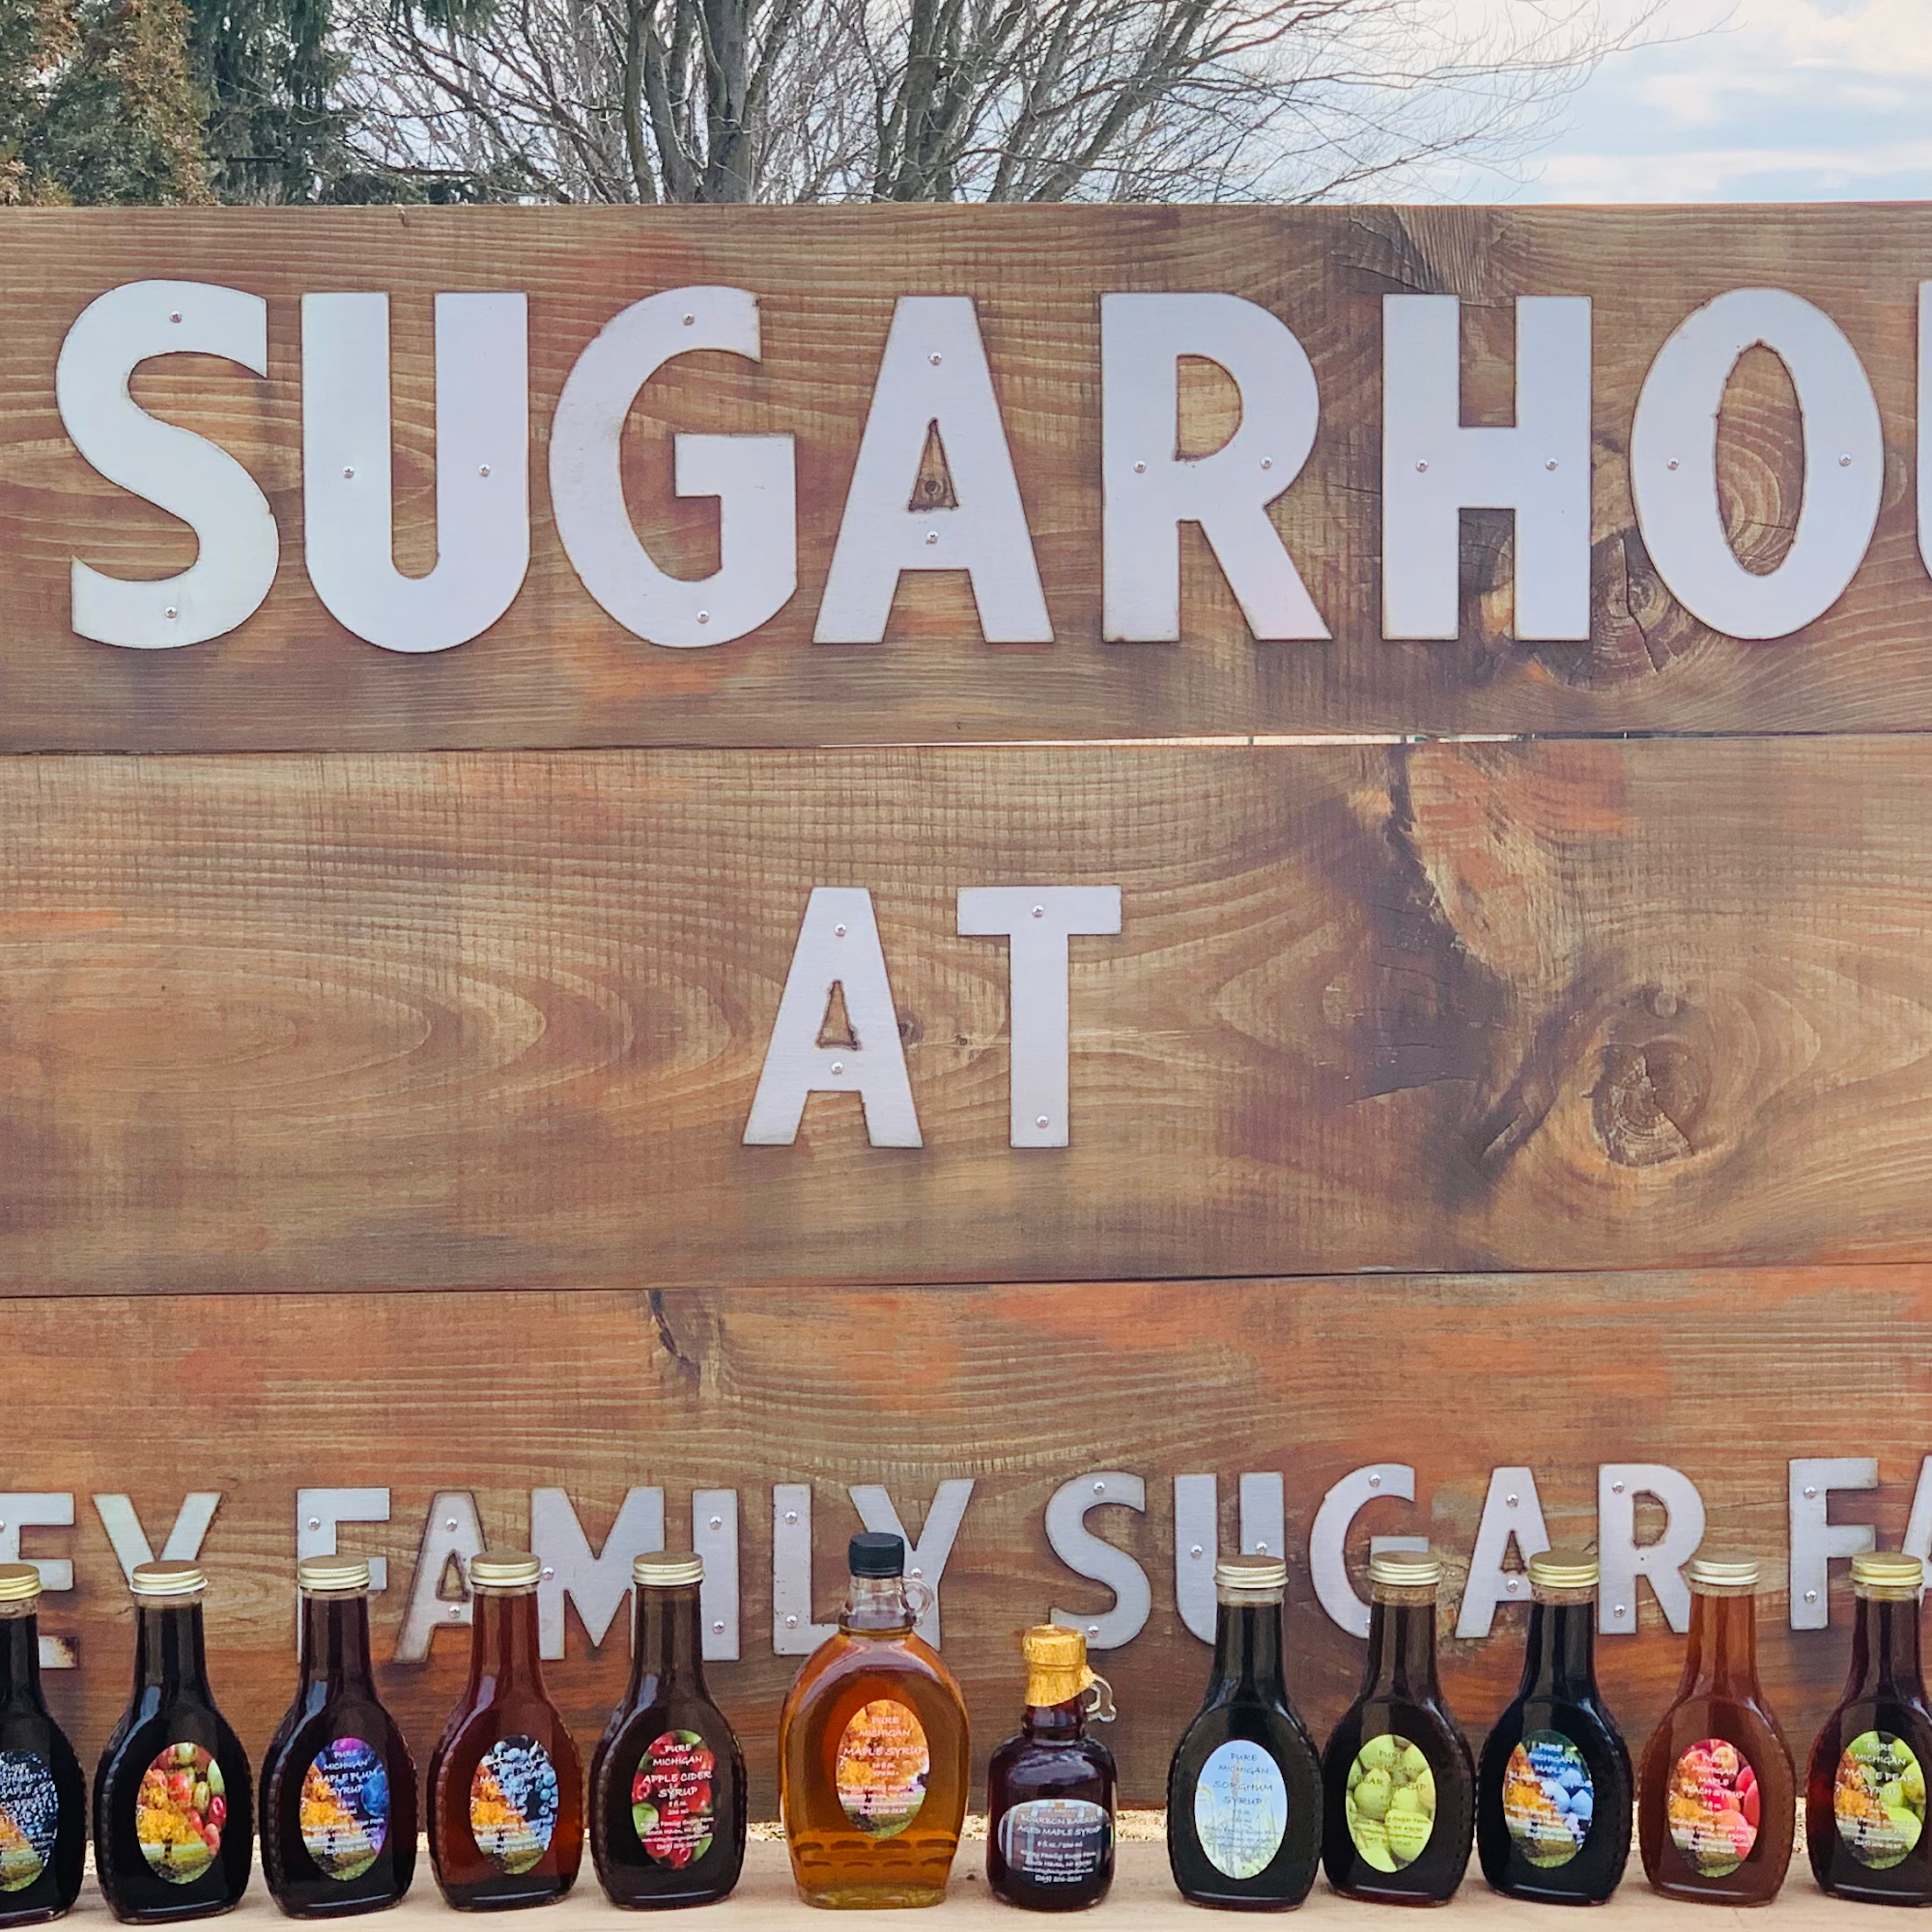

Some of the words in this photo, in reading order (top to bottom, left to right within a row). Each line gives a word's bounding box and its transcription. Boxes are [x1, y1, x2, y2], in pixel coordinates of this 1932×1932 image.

[55, 279, 1932, 653] SUGARHO
[742, 884, 1122, 1150] AT
[297, 1478, 976, 1664] FAMILY
[1044, 1462, 1706, 1650] SUGAR
[871, 1716, 899, 1724] PURE
[859, 1728, 911, 1738] MICHIGAN
[665, 1744, 692, 1753] PURE
[843, 1747, 884, 1756] MAPLE
[884, 1746, 925, 1758] SYRUP
[1539, 1742, 1563, 1752] PURE
[1867, 1742, 1894, 1751] PURE
[333, 1750, 358, 1759] PURE
[652, 1754, 703, 1767] MICHIGAN
[1230, 1752, 1258, 1762] PURE
[1527, 1752, 1574, 1765] MICHIGAN
[1855, 1752, 1907, 1767] MICHIGAN
[323, 1759, 368, 1772] MICHIGAN
[1218, 1764, 1269, 1776] MICHIGAN
[1535, 1764, 1567, 1775] MAPLE
[1691, 1764, 1738, 1776] MICHIGAN
[313, 1773, 349, 1784] MAPLE
[350, 1769, 378, 1782] PLUM
[642, 1774, 678, 1784] APPLE
[680, 1770, 714, 1781] CIDER
[1698, 1776, 1730, 1786] MAPLE
[1844, 1768, 1883, 1781] MAPLE
[1885, 1772, 1916, 1783] PEAR
[327, 1784, 364, 1798] SYRUP
[1212, 1779, 1273, 1793] SORGHUM
[1683, 1784, 1713, 1797] PEACH
[1713, 1789, 1746, 1801] SYRUP
[1861, 1785, 1897, 1798] SYRUP
[658, 1785, 698, 1801] SYRUP
[1223, 1796, 1263, 1806] SYRUP
[1020, 1813, 1065, 1826] BOURBON
[1066, 1815, 1099, 1826] BARREL
[1016, 1825, 1041, 1835] AGED
[1042, 1828, 1073, 1836] MAPLE
[1074, 1825, 1102, 1837] SYRUP
